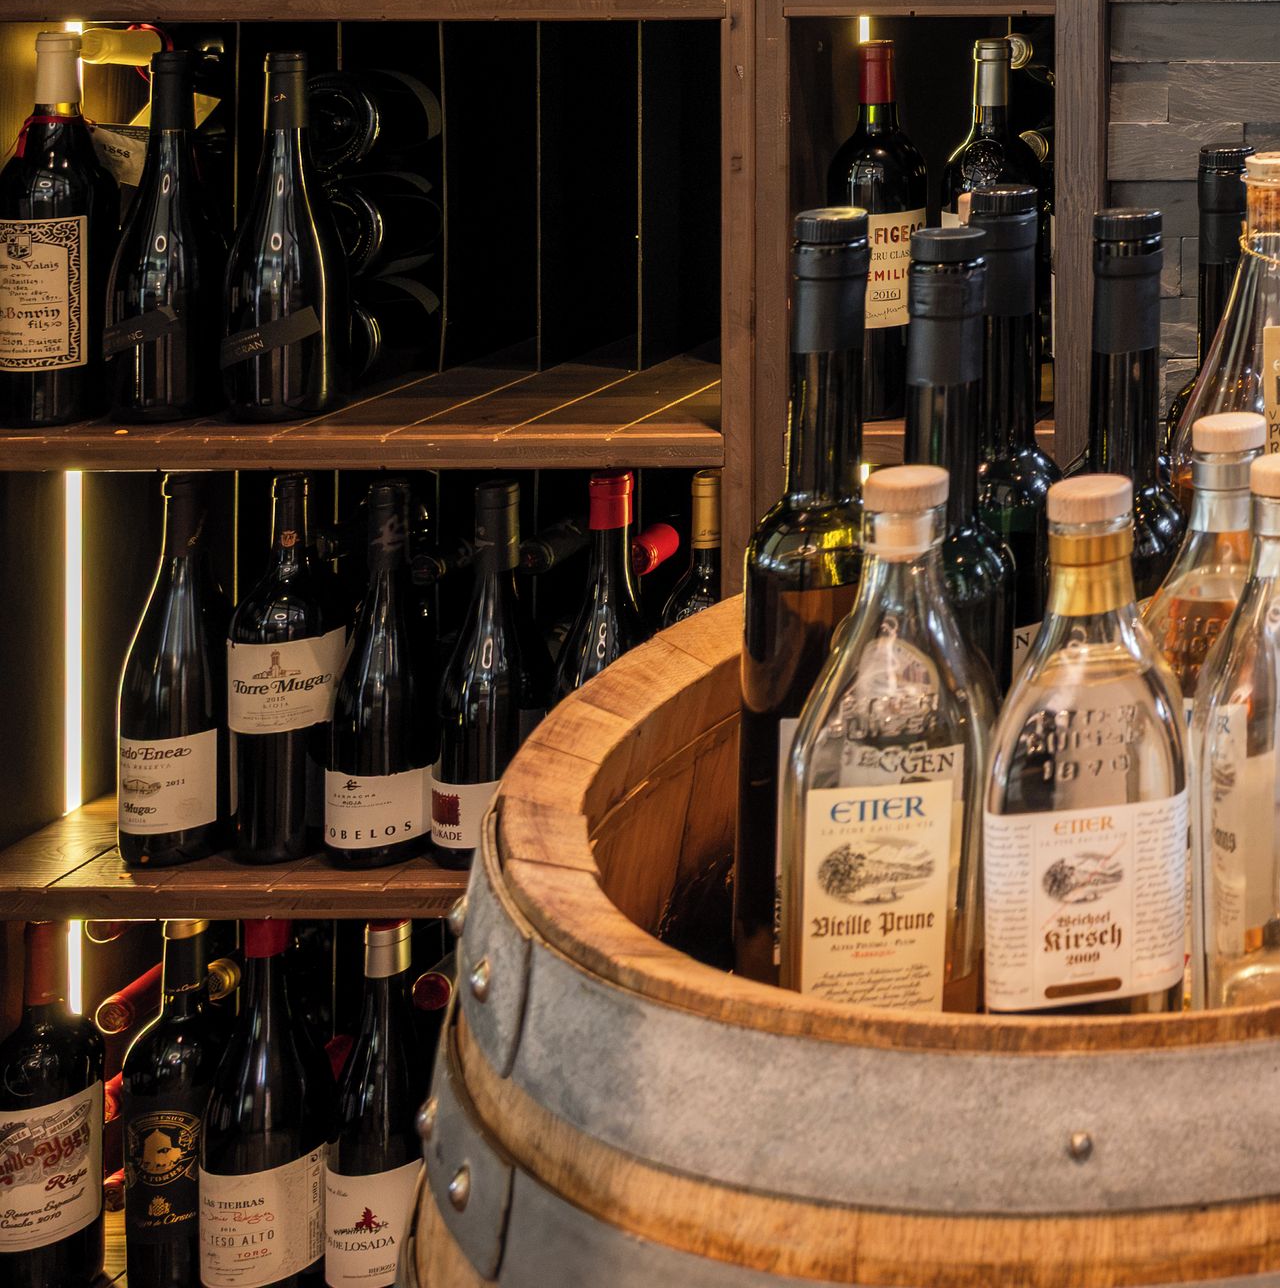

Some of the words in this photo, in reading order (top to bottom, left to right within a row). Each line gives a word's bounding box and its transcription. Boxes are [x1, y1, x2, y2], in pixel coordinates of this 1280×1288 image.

[24, 260, 60, 272] Valais
[872, 288, 897, 300] 2016
[6, 307, 60, 322] Bonvin
[233, 679, 269, 695] Torre
[270, 673, 332, 694] Muga
[138, 746, 192, 761] Enea
[166, 778, 185, 788] 2011
[124, 802, 157, 816] Muga
[830, 796, 926, 824] ETTER
[1053, 816, 1116, 834] ETTER
[811, 913, 872, 940] Vieille
[879, 911, 937, 937] Prune
[1044, 922, 1122, 954] Kirsch
[1065, 950, 1100, 966] 2009
[45, 1168, 88, 1191] Rioja
[218, 1196, 265, 1210] TIERRAS
[36, 1212, 62, 1224] 2010
[210, 1234, 235, 1247] TESO
[242, 1230, 275, 1246] ALTO
[344, 1236, 395, 1252] LOSADA
[238, 1248, 268, 1259] TORO
